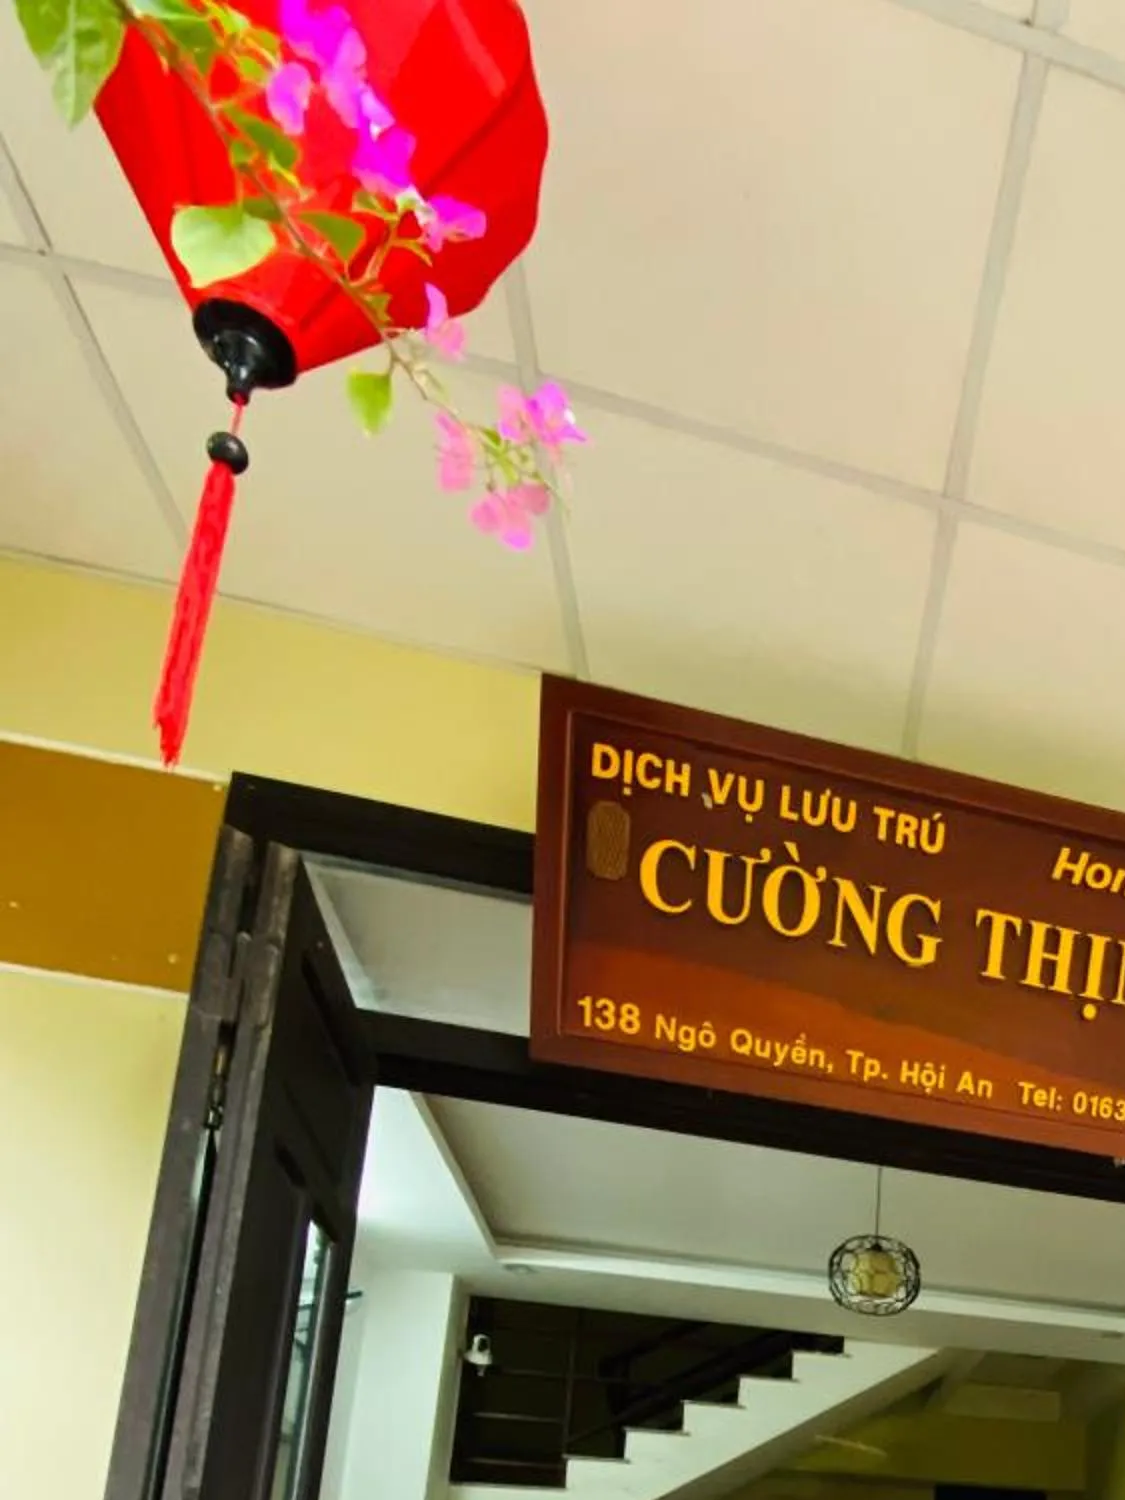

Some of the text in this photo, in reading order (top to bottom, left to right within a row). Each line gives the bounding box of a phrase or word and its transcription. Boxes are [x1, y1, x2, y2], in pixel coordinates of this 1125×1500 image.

[591, 742, 947, 855] DỊCH VỤ LƯU TRÚ
[638, 838, 943, 968] CƯỜNG
[577, 995, 641, 1035] 138
[654, 1013, 717, 1052] Ngô
[845, 1049, 889, 1083] Tp.
[899, 1060, 946, 1094] Hội
[955, 1071, 994, 1099] An
[1018, 1080, 1064, 1111] Tel:
